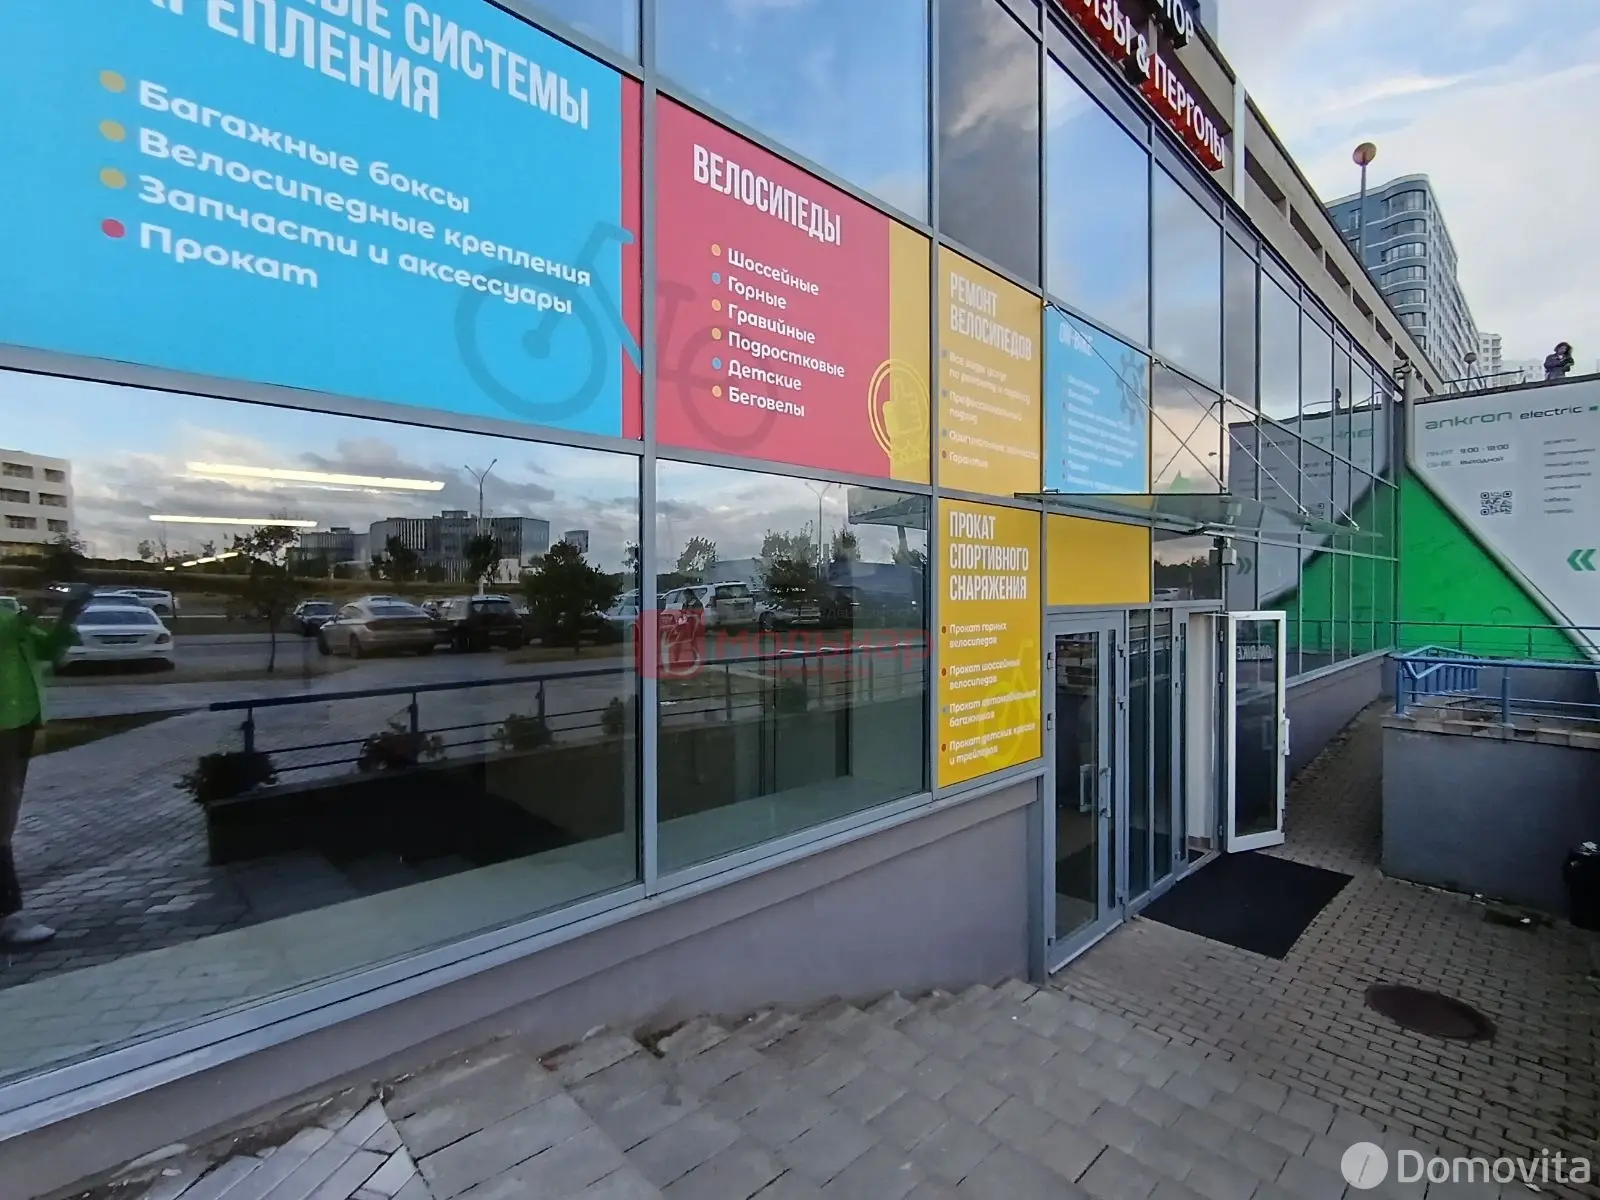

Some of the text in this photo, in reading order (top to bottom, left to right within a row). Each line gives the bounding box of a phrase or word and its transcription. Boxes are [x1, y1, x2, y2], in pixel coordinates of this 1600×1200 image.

[147, 0, 439, 119] ЕПЛЕНИЯ
[404, 2, 588, 130] СИСТЕМЫ
[1136, 34, 1150, 79] &
[1154, 52, 1226, 168] ПЕРГОЛЫ
[139, 78, 470, 214] Багажные боксы
[139, 127, 591, 287] Велосипедные крепления
[693, 143, 842, 246] ВЕЛОСИПЕДЫ
[138, 173, 573, 315] Запчасти и аксессуары
[140, 220, 318, 288] Прокат
[728, 247, 819, 296] Шоссейные
[728, 275, 787, 310] Горные
[950, 271, 998, 318] РЕМОНТ
[728, 303, 816, 344] Гравийные
[950, 304, 1032, 362] ВЕЛОСИПЕДОВ
[728, 331, 845, 378] Подростковые
[728, 359, 802, 391] Детские
[728, 386, 805, 417] Беговелы
[1425, 405, 1584, 430] ankron electric
[950, 511, 996, 540] ПРОКАТ
[950, 543, 1029, 571] СПОРТИВНОГО
[950, 575, 1027, 600] СНАРЯЖЕНИЯ
[949, 623, 981, 635] Прокат
[949, 664, 981, 677] Прокат
[949, 700, 981, 714] Прокат
[949, 736, 981, 752] Прокат
